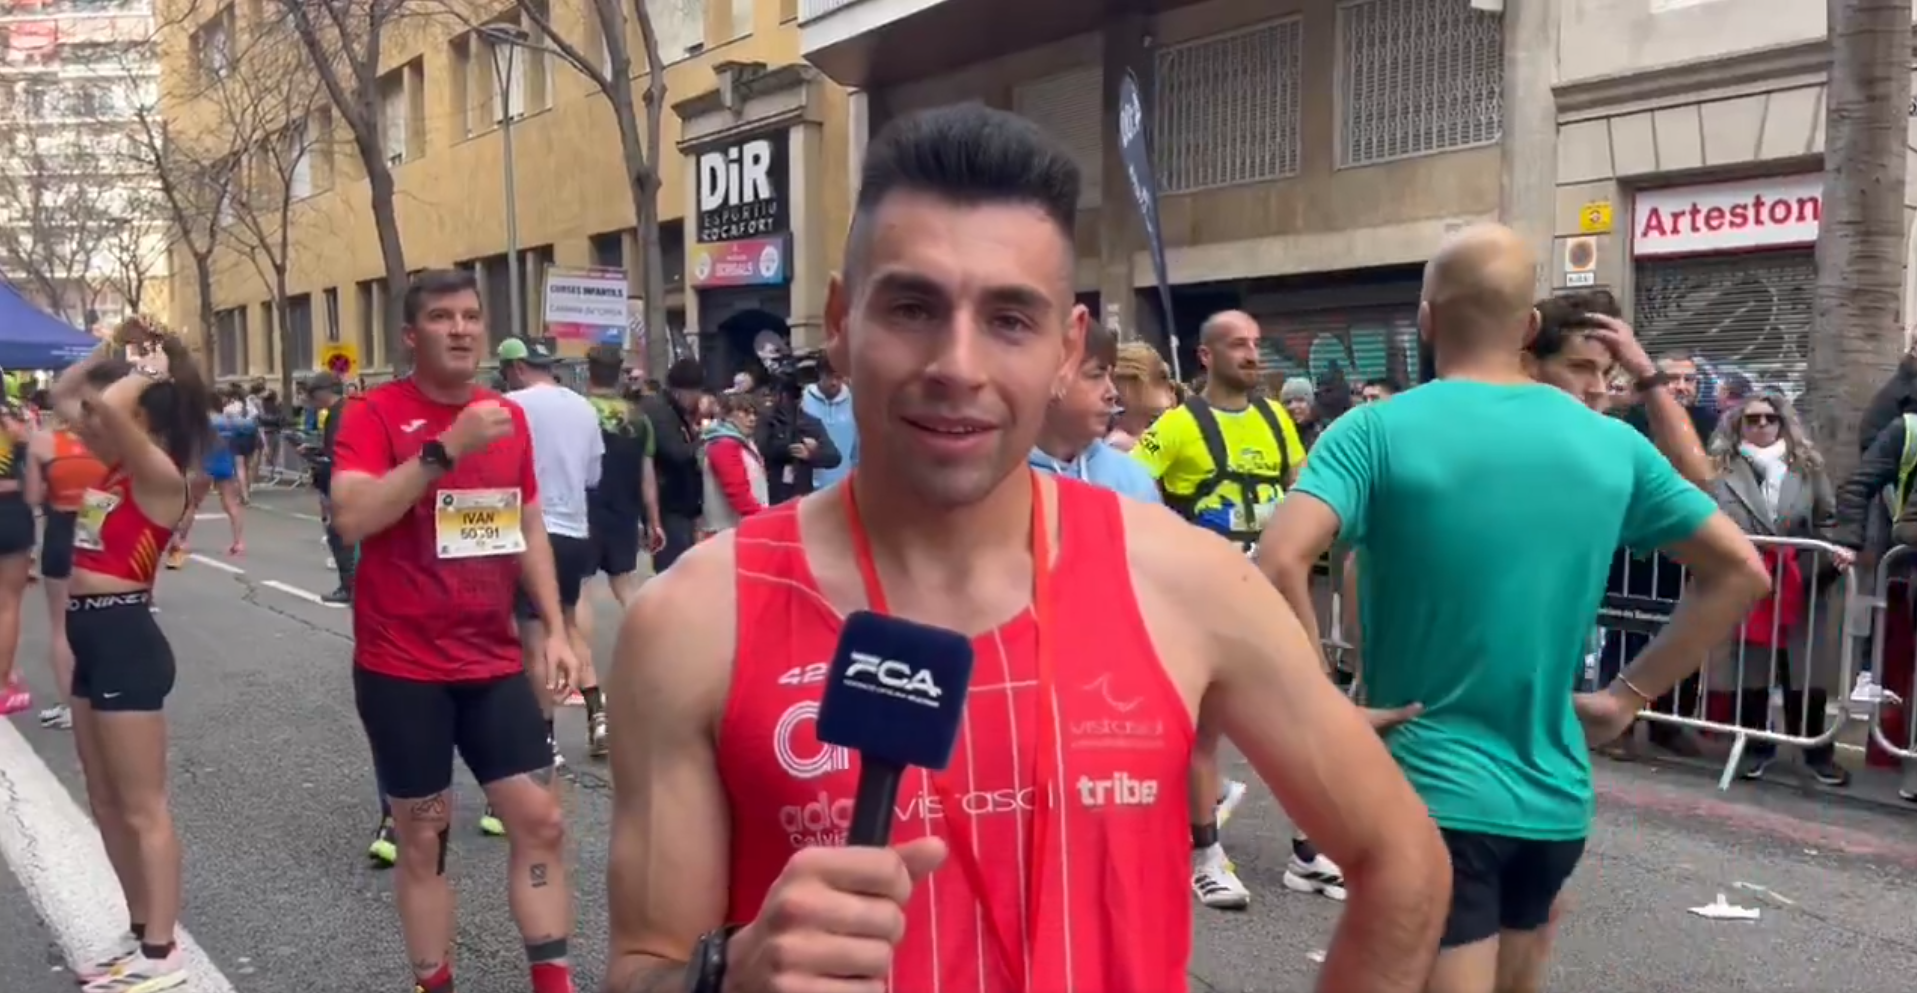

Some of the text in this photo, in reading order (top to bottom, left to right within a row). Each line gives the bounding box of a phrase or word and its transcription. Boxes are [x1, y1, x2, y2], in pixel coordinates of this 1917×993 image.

[700, 139, 771, 212] DiR
[1641, 194, 1820, 238] Arteston
[462, 511, 495, 525] IVAN
[845, 651, 942, 698] FCA
[1076, 771, 1158, 805] tribe
